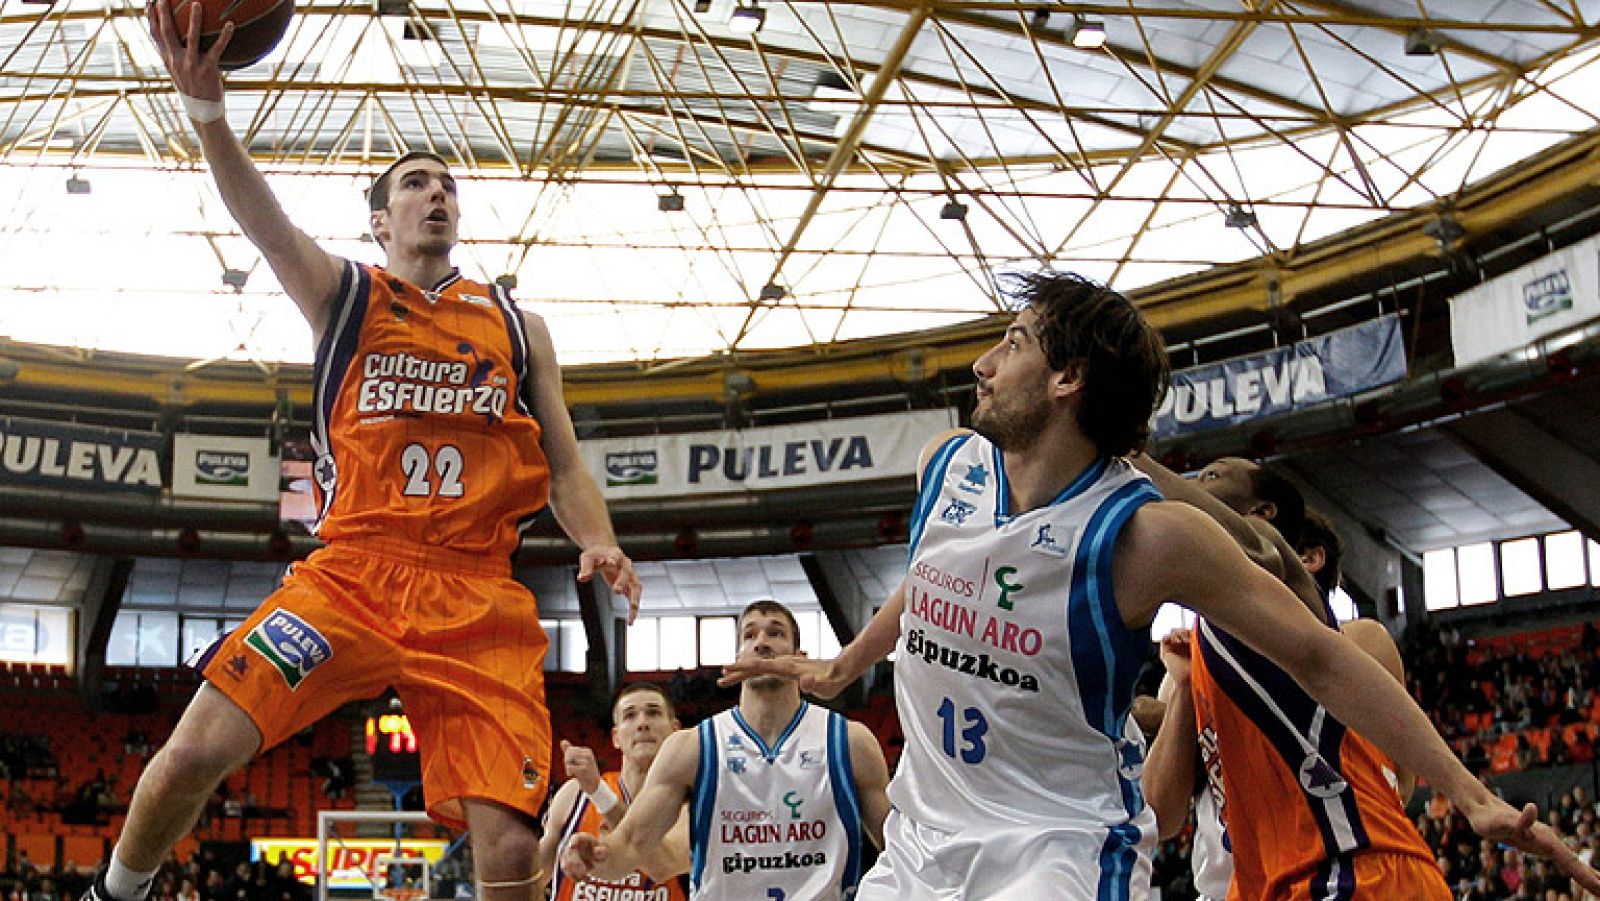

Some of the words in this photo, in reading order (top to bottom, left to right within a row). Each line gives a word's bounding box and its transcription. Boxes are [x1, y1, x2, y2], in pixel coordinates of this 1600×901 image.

[364, 353, 468, 384] Cultura
[0, 431, 162, 487] ULEVA
[401, 443, 464, 497] 22
[688, 436, 873, 484] PULEVA
[916, 561, 974, 597] SEGUROS
[911, 586, 977, 638] LAGUN
[981, 617, 1043, 656] ARO
[906, 629, 1040, 692] gipuzkoa
[937, 697, 988, 765] 13
[722, 824, 781, 843] LAGUN
[787, 819, 826, 841] ARO
[723, 850, 826, 874] gipuzkoa
